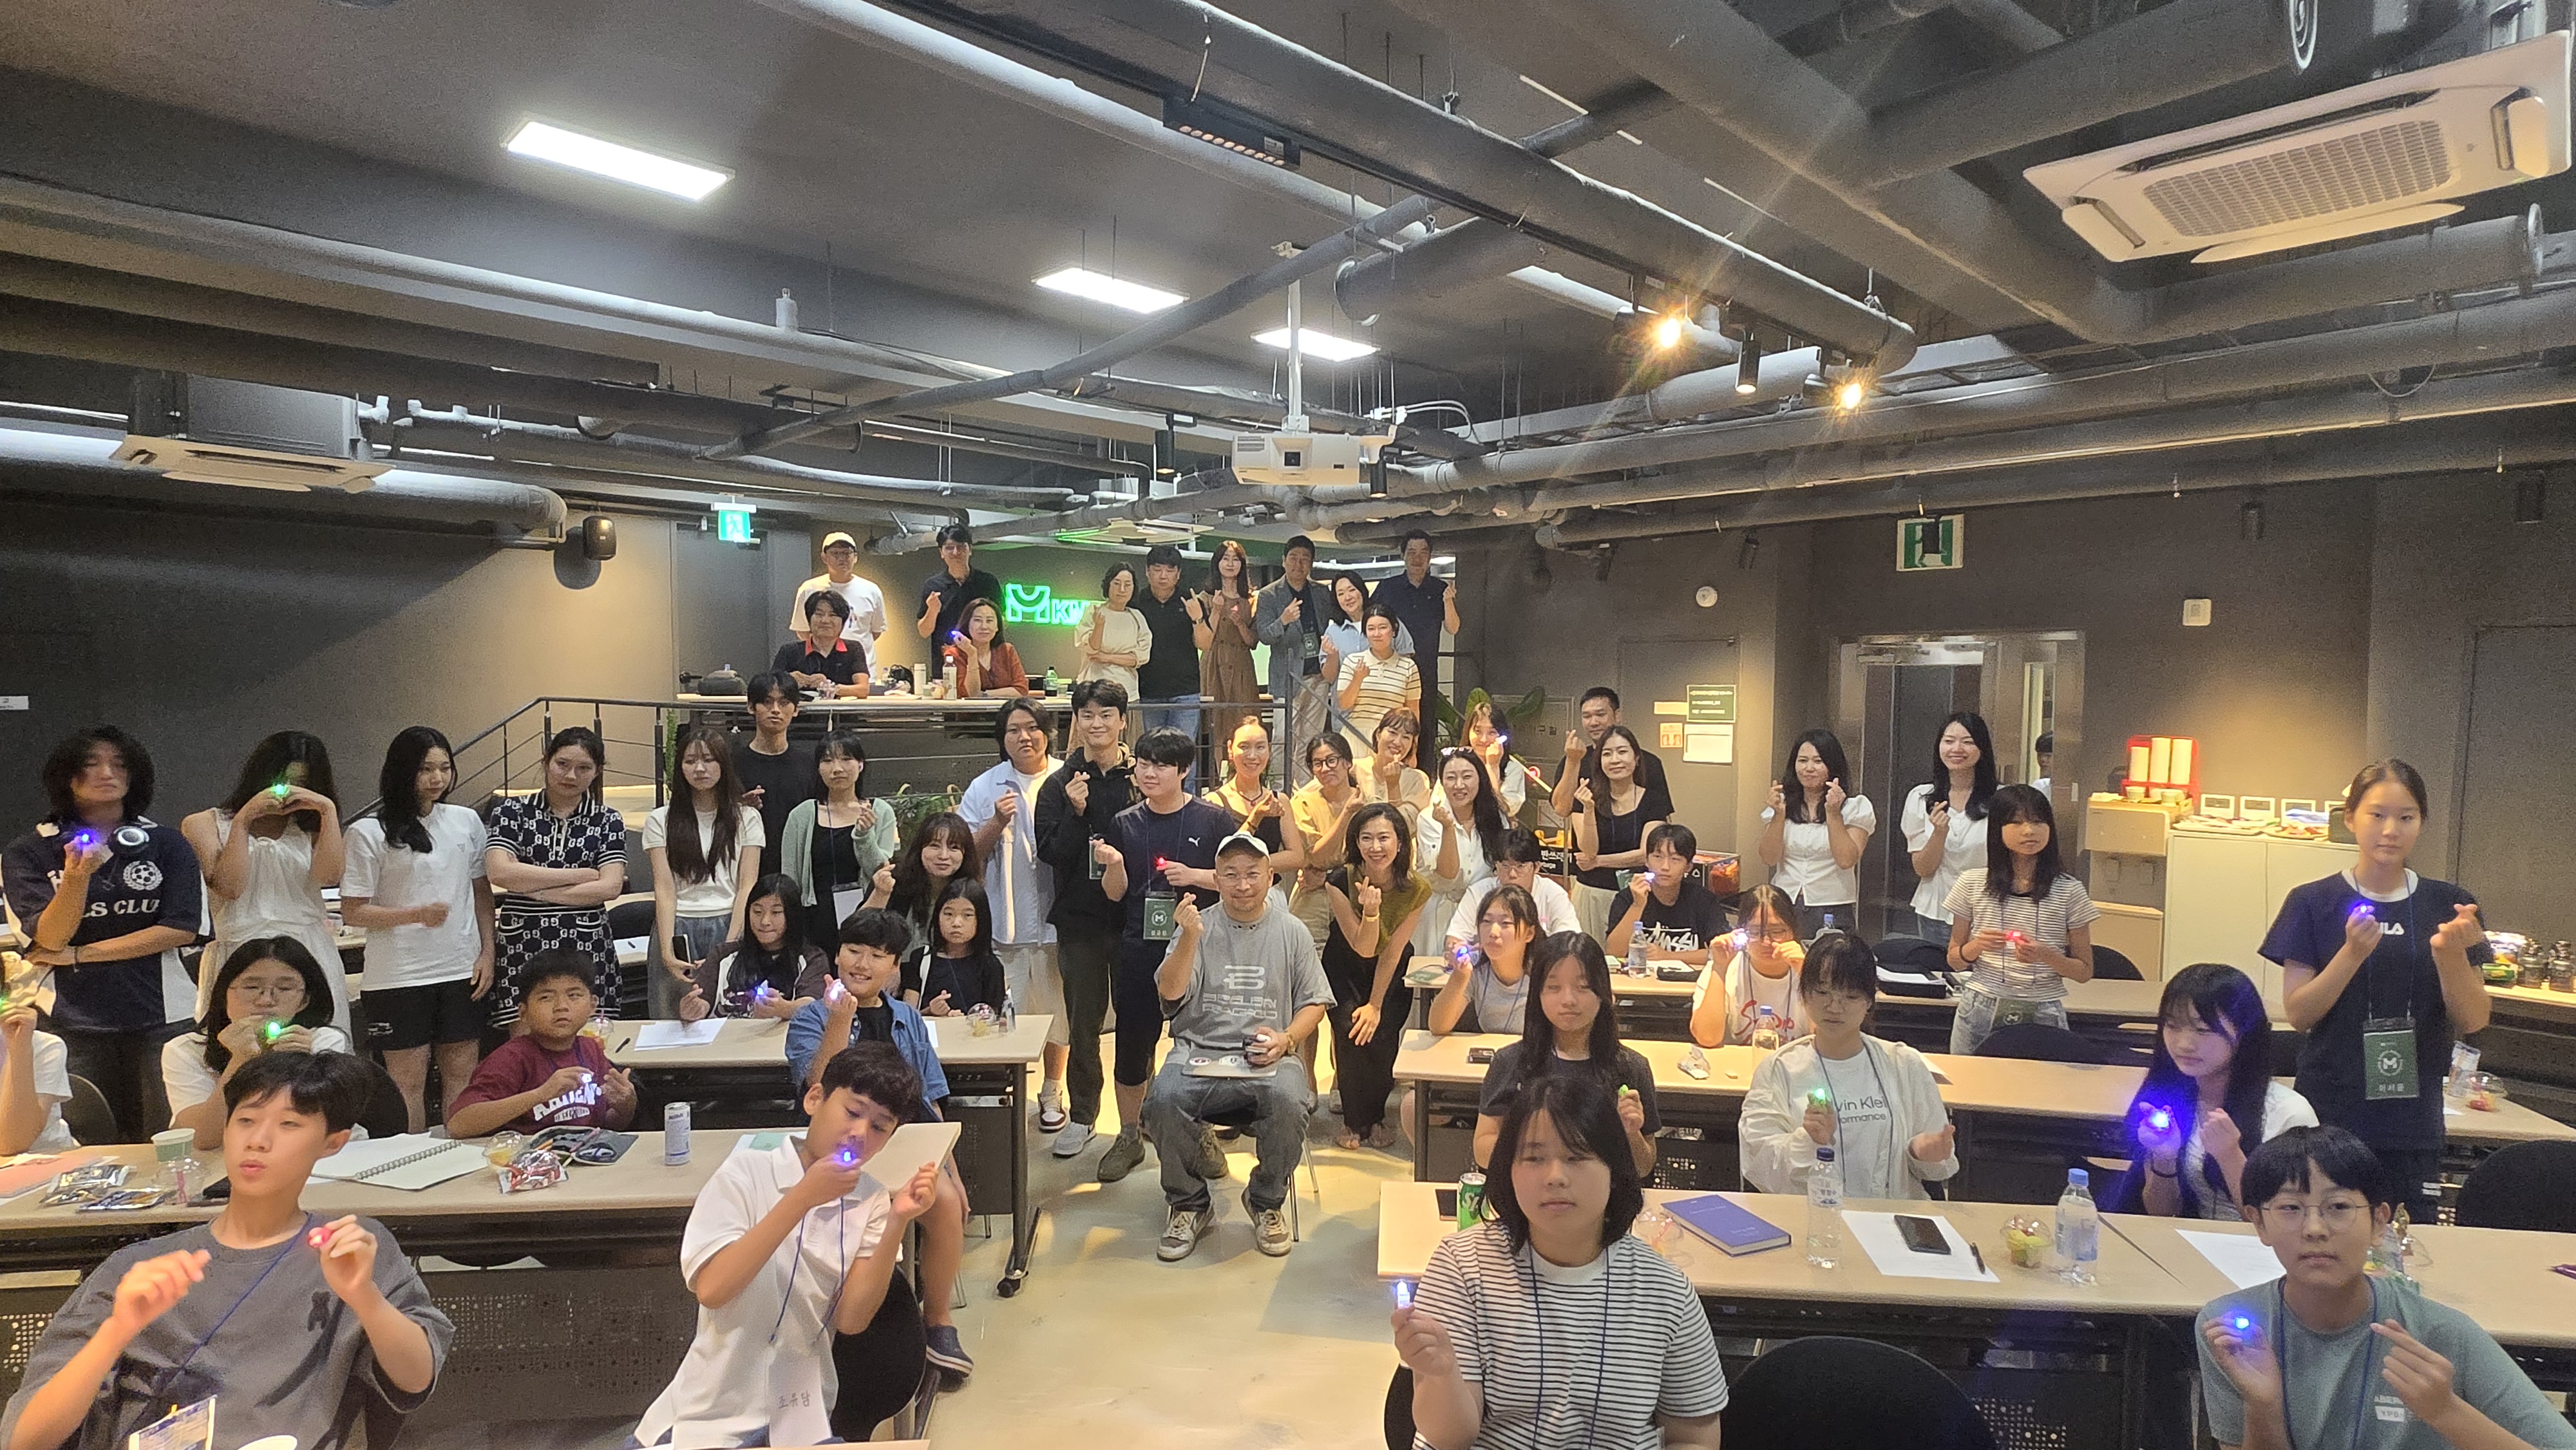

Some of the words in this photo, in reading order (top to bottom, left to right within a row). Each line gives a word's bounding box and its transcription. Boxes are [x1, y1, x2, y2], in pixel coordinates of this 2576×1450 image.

[2380, 922, 2404, 935] ILA
[1860, 1096, 1888, 1109] Klei
[1841, 1113, 1886, 1124] ormance
